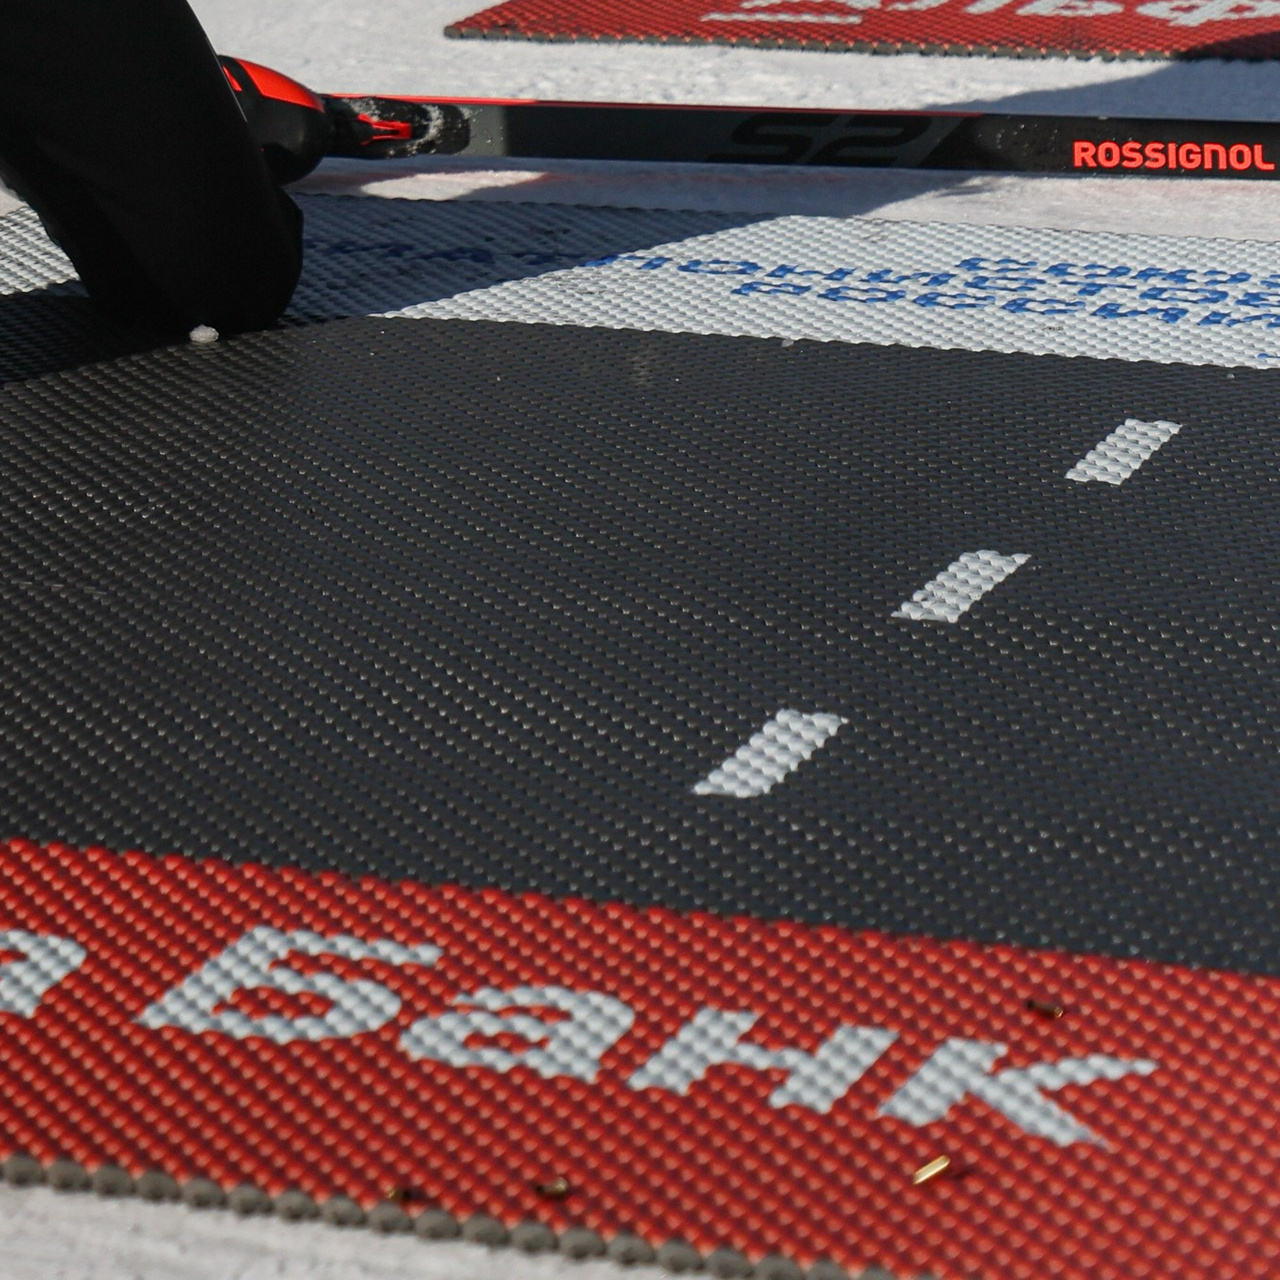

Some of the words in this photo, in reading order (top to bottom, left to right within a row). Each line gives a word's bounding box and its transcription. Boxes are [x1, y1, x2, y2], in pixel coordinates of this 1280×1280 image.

[1073, 141, 1275, 171] ROSSIGNOL
[953, 257, 1280, 290] СОЮ
[132, 924, 1160, 1151] Банк
